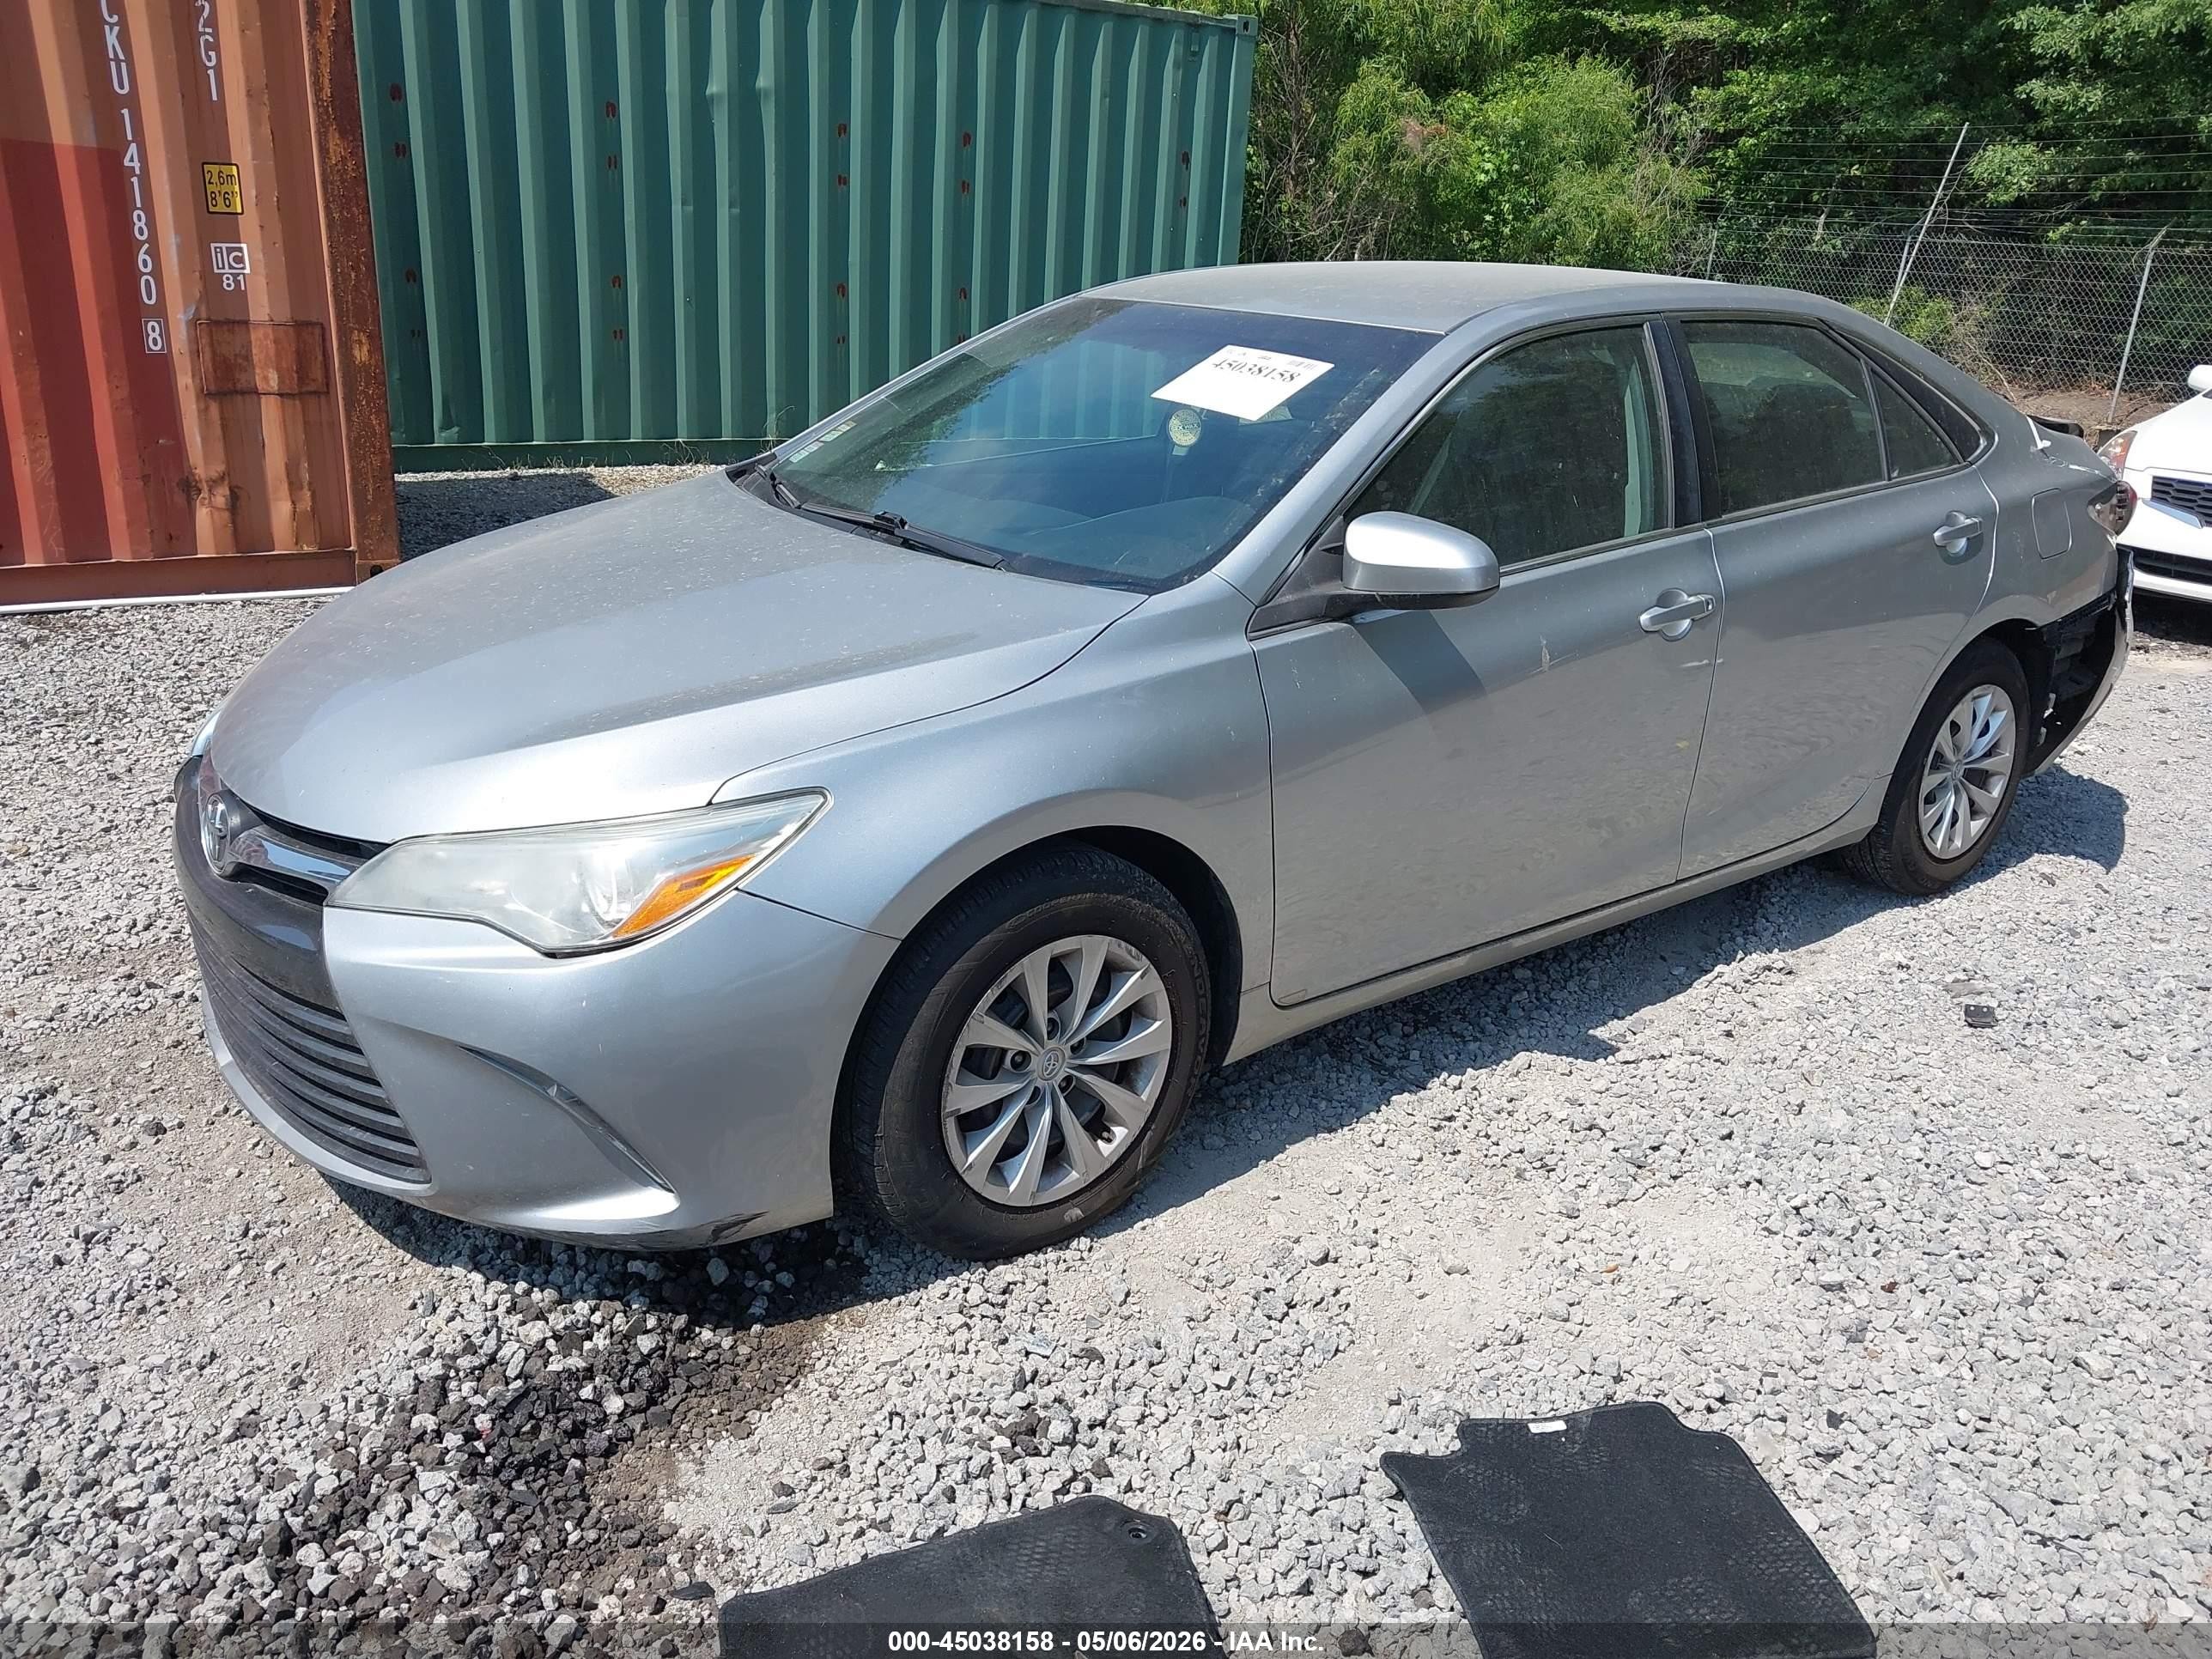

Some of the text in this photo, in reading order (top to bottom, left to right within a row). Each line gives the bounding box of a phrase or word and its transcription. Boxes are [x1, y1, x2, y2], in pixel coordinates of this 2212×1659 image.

[119, 108, 157, 305] 141860
[146, 322, 163, 351] 8
[222, 274, 246, 291] 81
[1212, 358, 1301, 383] 45038158
